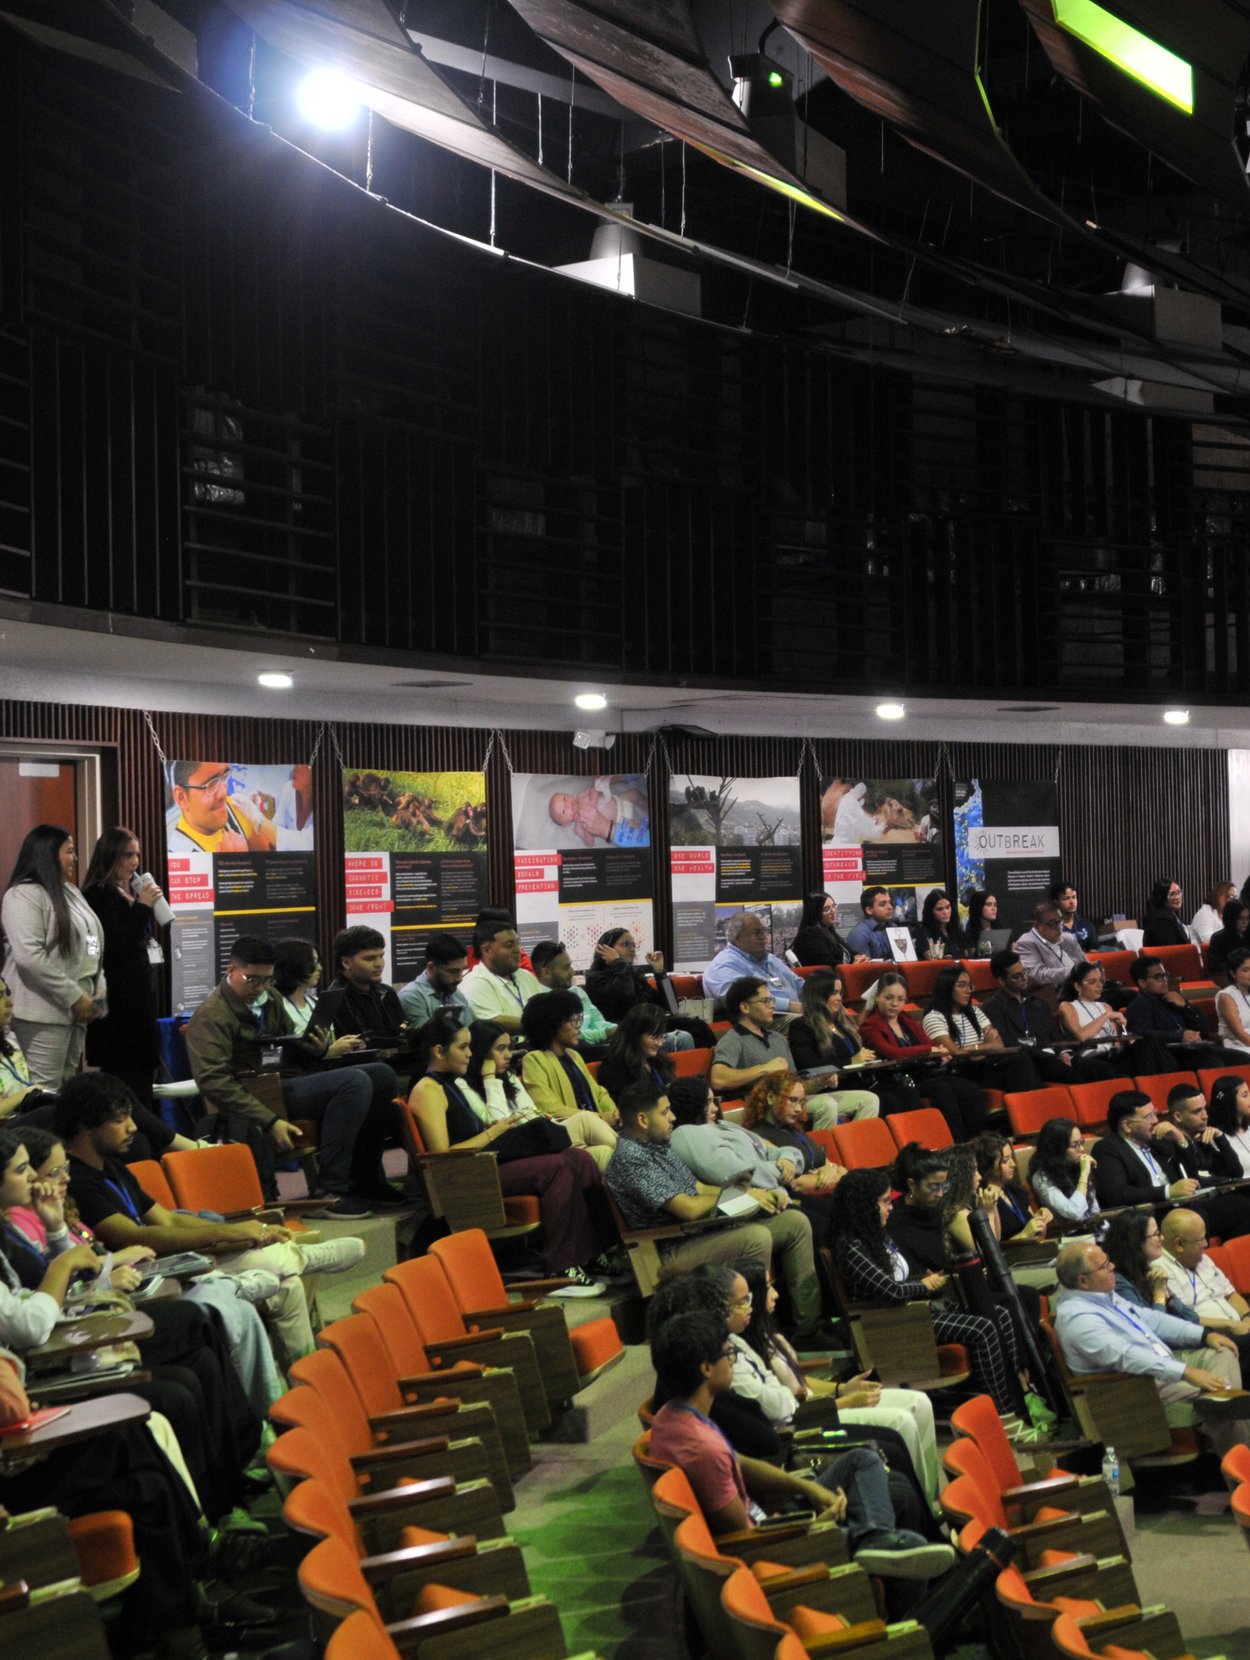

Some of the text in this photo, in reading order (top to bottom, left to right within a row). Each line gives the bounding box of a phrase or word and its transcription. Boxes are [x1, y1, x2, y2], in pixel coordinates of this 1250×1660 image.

[979, 834, 1045, 849] OUTBREAK
[517, 856, 558, 864] VACCINATION
[674, 852, 709, 860] ONE WORLD
[348, 859, 379, 867] WHERE DO
[674, 864, 713, 872] ONE HEALTH
[348, 874, 379, 882] ZOONOTIC
[517, 870, 539, 878] EQUALS
[184, 876, 201, 884] STOP
[518, 882, 555, 891] PREVENTION
[185, 892, 210, 900] SPREAD
